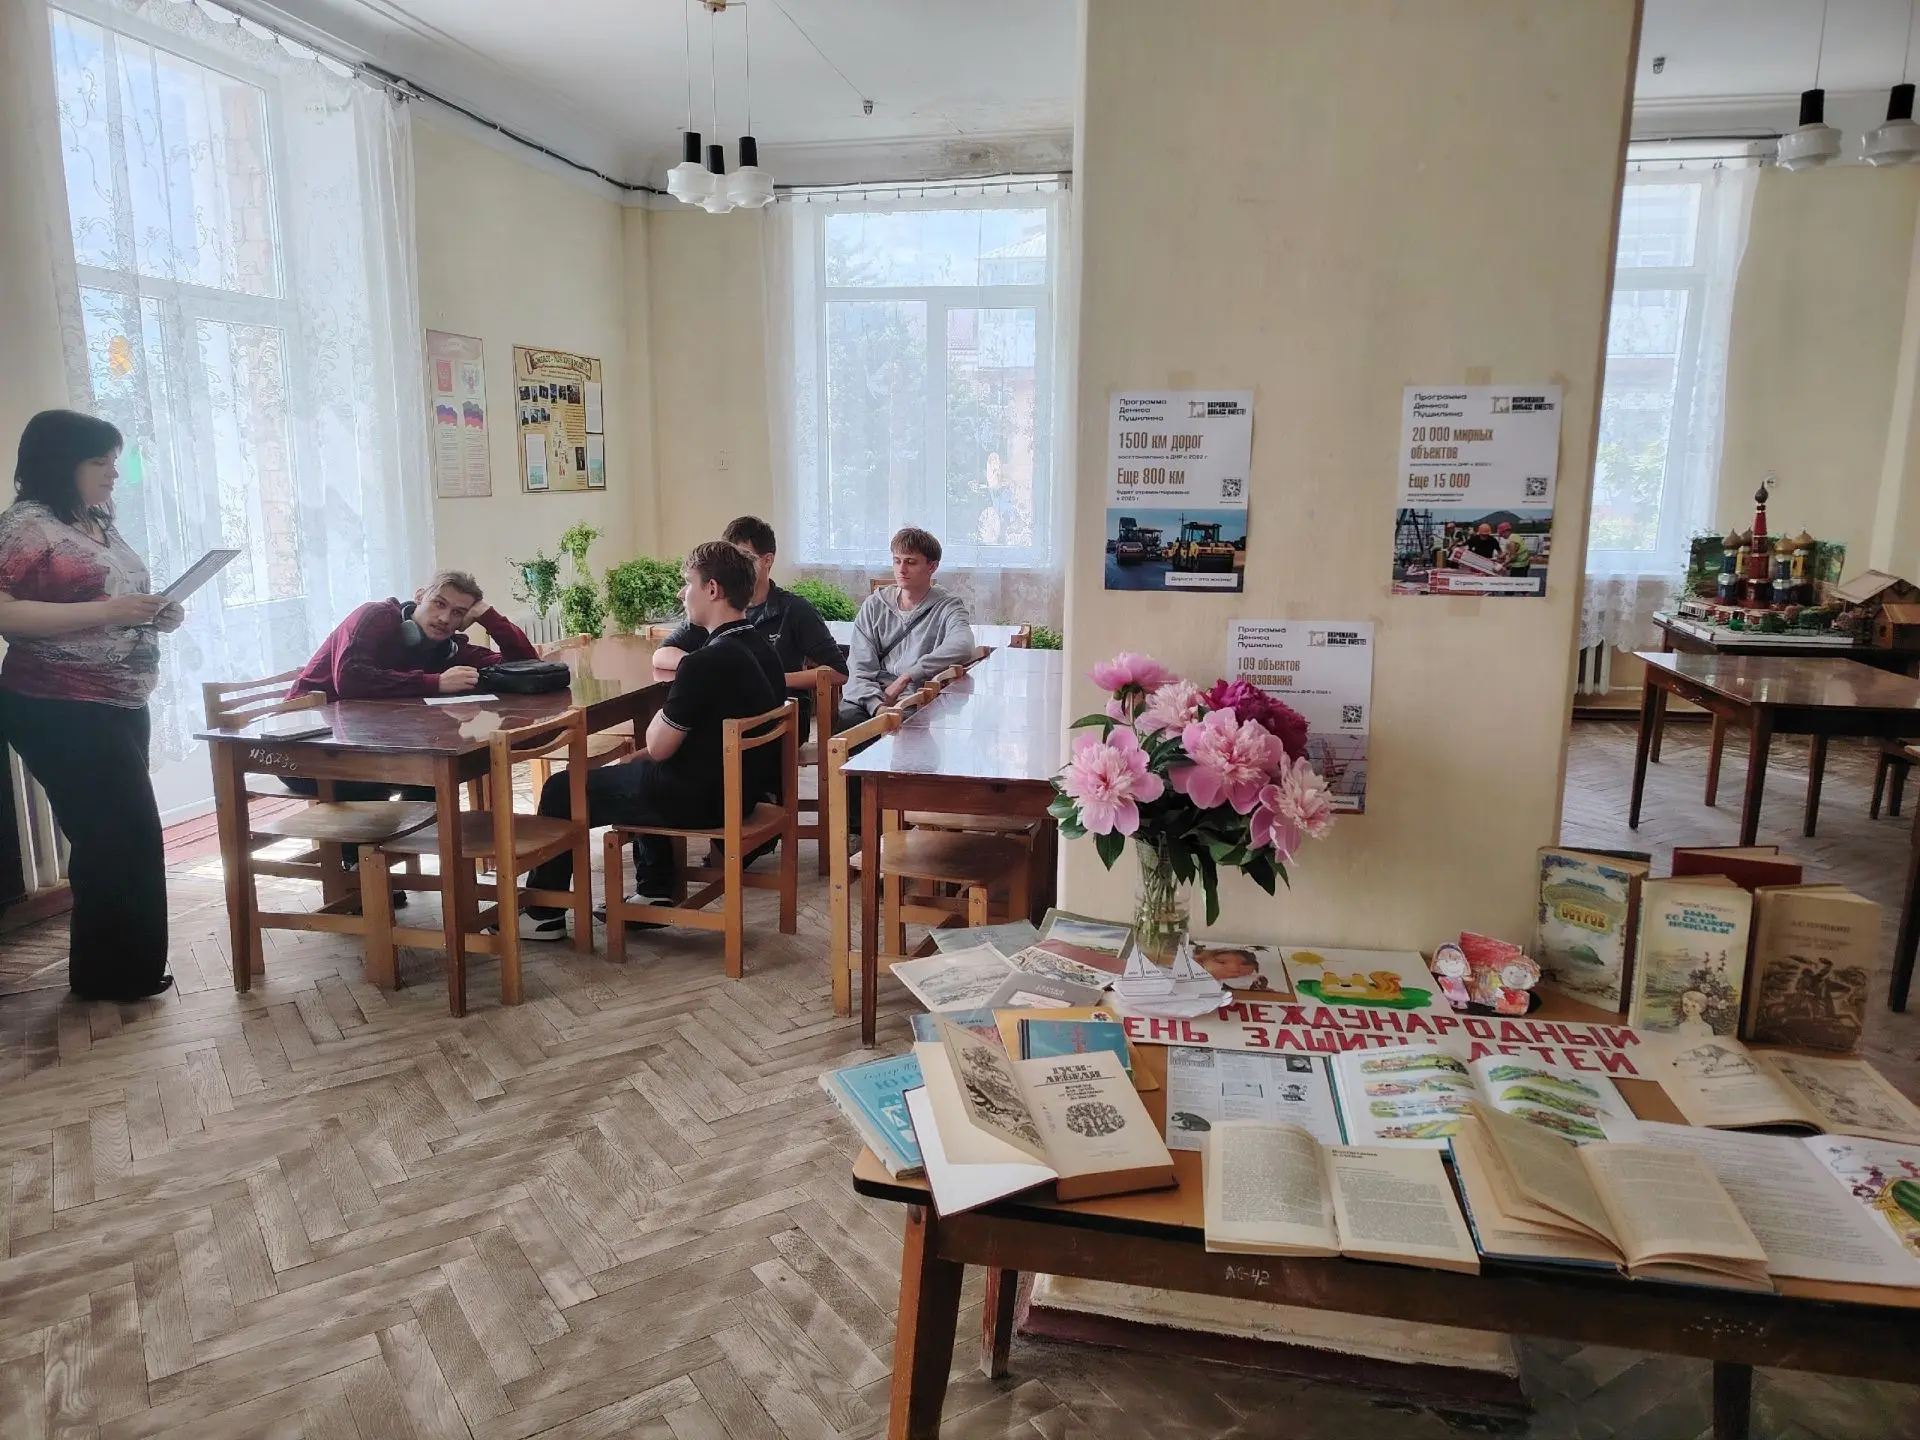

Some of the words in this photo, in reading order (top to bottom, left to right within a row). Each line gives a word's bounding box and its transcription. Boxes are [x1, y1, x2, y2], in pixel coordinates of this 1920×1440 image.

[1119, 398, 1167, 406] Программа
[1414, 393, 1467, 401] Программа
[1118, 406, 1151, 414] Дениса
[1413, 402, 1449, 410] Дениса
[1118, 414, 1164, 422] Пушилина
[1413, 410, 1463, 418] Пушилина
[1412, 427, 1426, 442] 20
[1429, 427, 1451, 442] 000
[1453, 428, 1494, 443] мирных
[1119, 432, 1148, 449] 1500
[1151, 434, 1168, 449] км
[1171, 434, 1204, 451] дорог
[1410, 445, 1458, 460] объектов
[1117, 467, 1139, 486] Еще
[1142, 468, 1165, 485] 800
[1169, 470, 1185, 485] км
[1408, 473, 1429, 490] Еще
[1433, 474, 1446, 488] 15
[1449, 474, 1470, 488] 000
[1237, 626, 1287, 634] Программа
[1237, 641, 1283, 649] Пушилина
[1238, 656, 1255, 670] 109
[1258, 657, 1301, 672] объектов
[1123, 1015, 1209, 1043] ЕНЬ
[1217, 1001, 1641, 1049] МЕЖДУНАРОДНЫЙ
